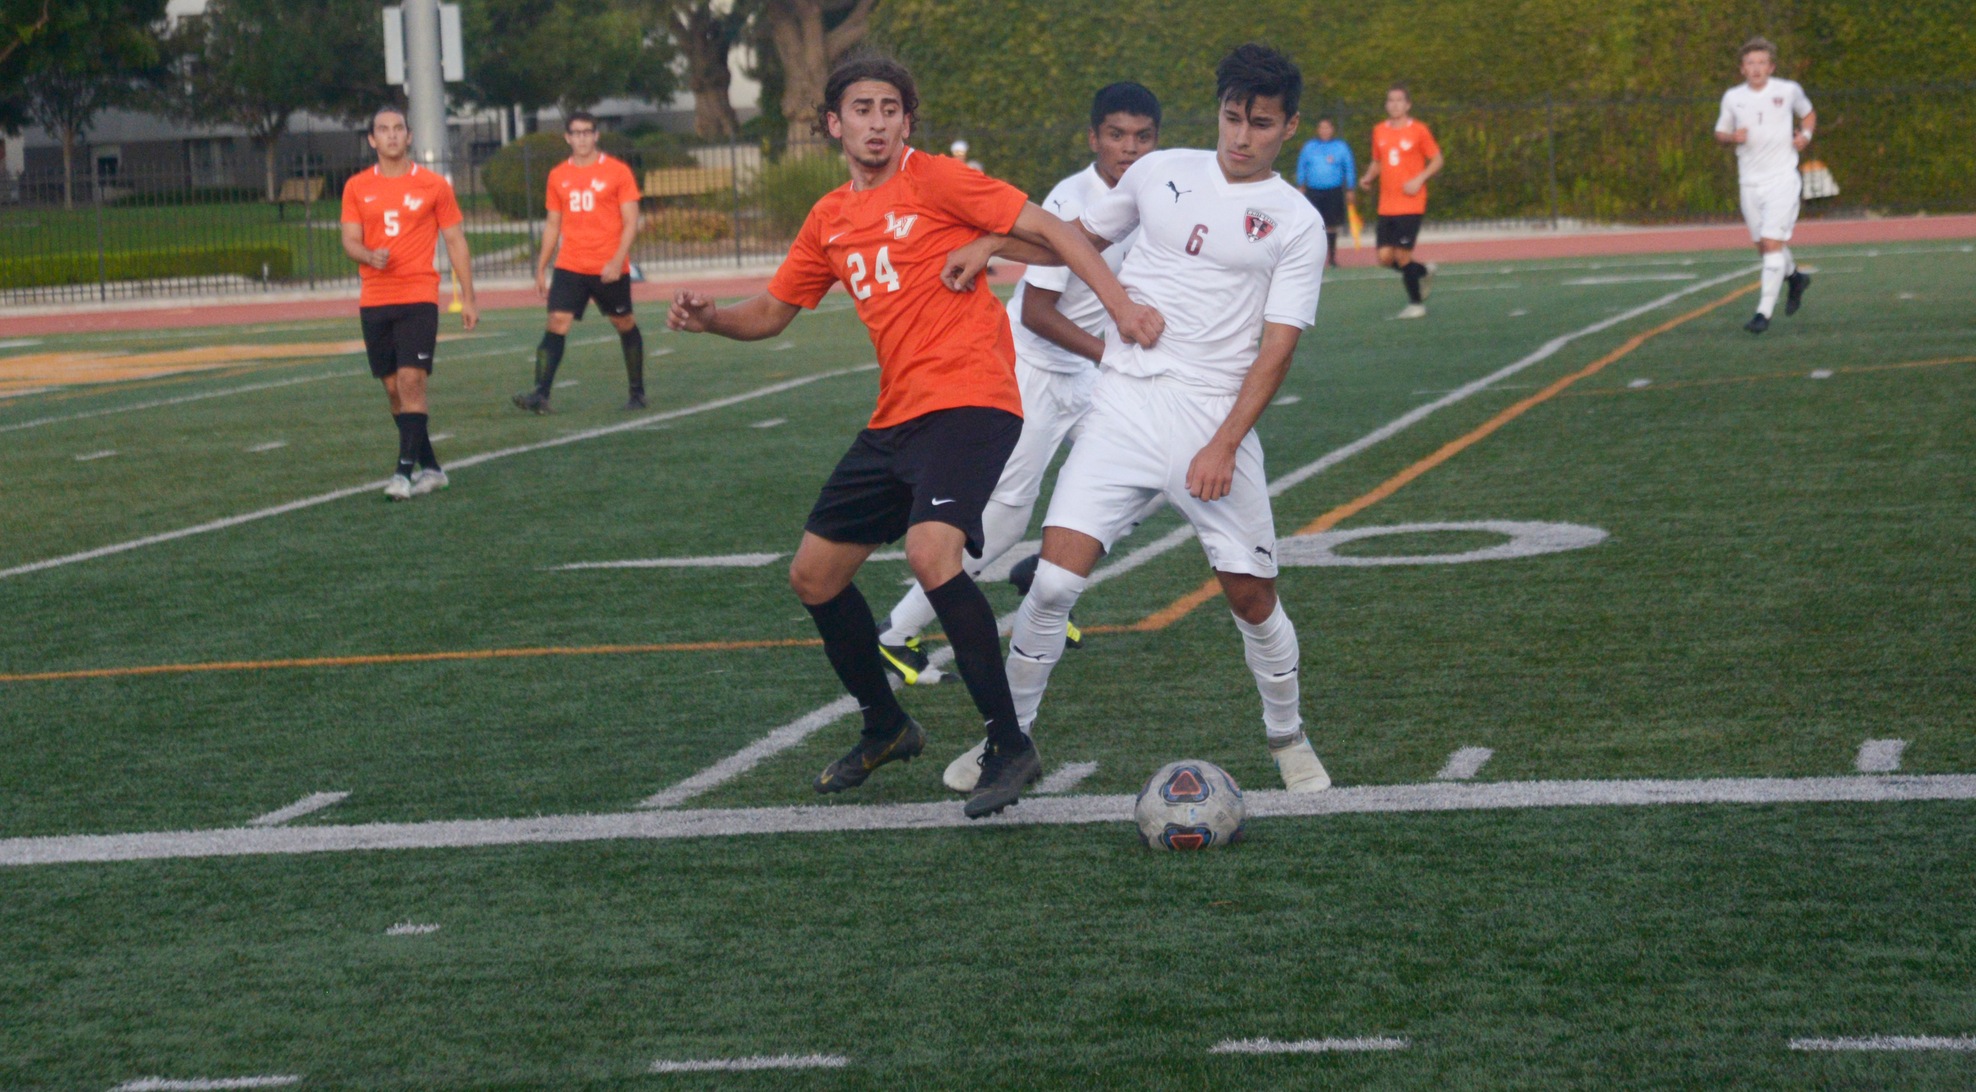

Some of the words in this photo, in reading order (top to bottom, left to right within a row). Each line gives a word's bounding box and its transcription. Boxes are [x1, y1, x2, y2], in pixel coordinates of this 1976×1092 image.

[569, 189, 594, 212] 20
[383, 210, 399, 237] 5
[884, 211, 917, 240] LV
[1185, 223, 1209, 256] 6
[846, 245, 900, 301] 24
